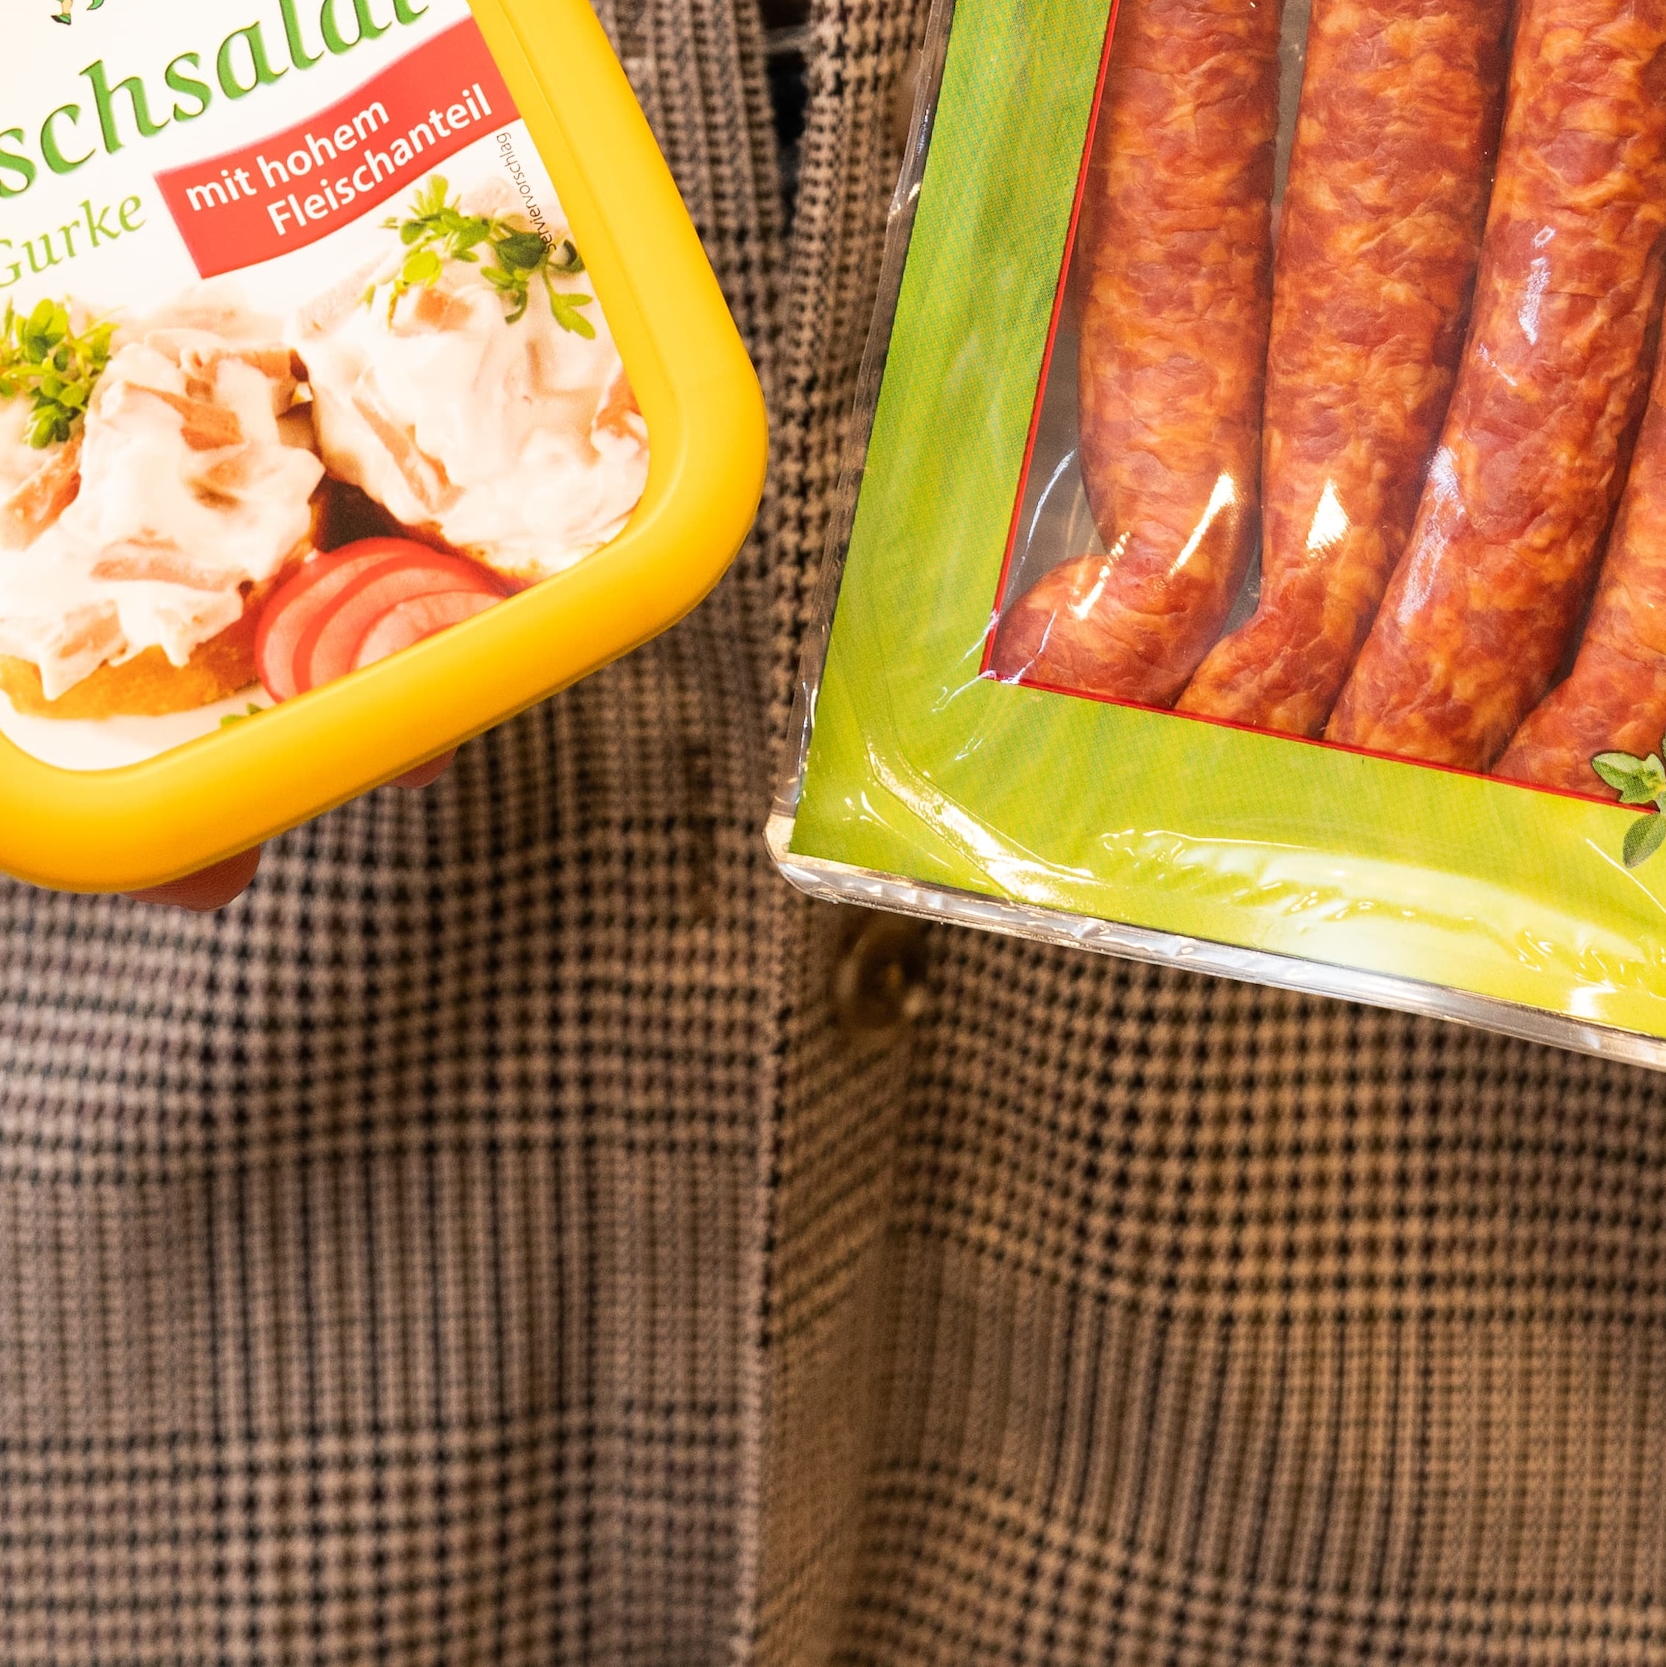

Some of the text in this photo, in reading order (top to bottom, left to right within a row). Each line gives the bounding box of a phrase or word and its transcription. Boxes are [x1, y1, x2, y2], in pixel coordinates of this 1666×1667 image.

[184, 96, 392, 213] mit hohem
[265, 83, 493, 238] Fleischanteil
[496, 131, 557, 253] Serviervorschlag
